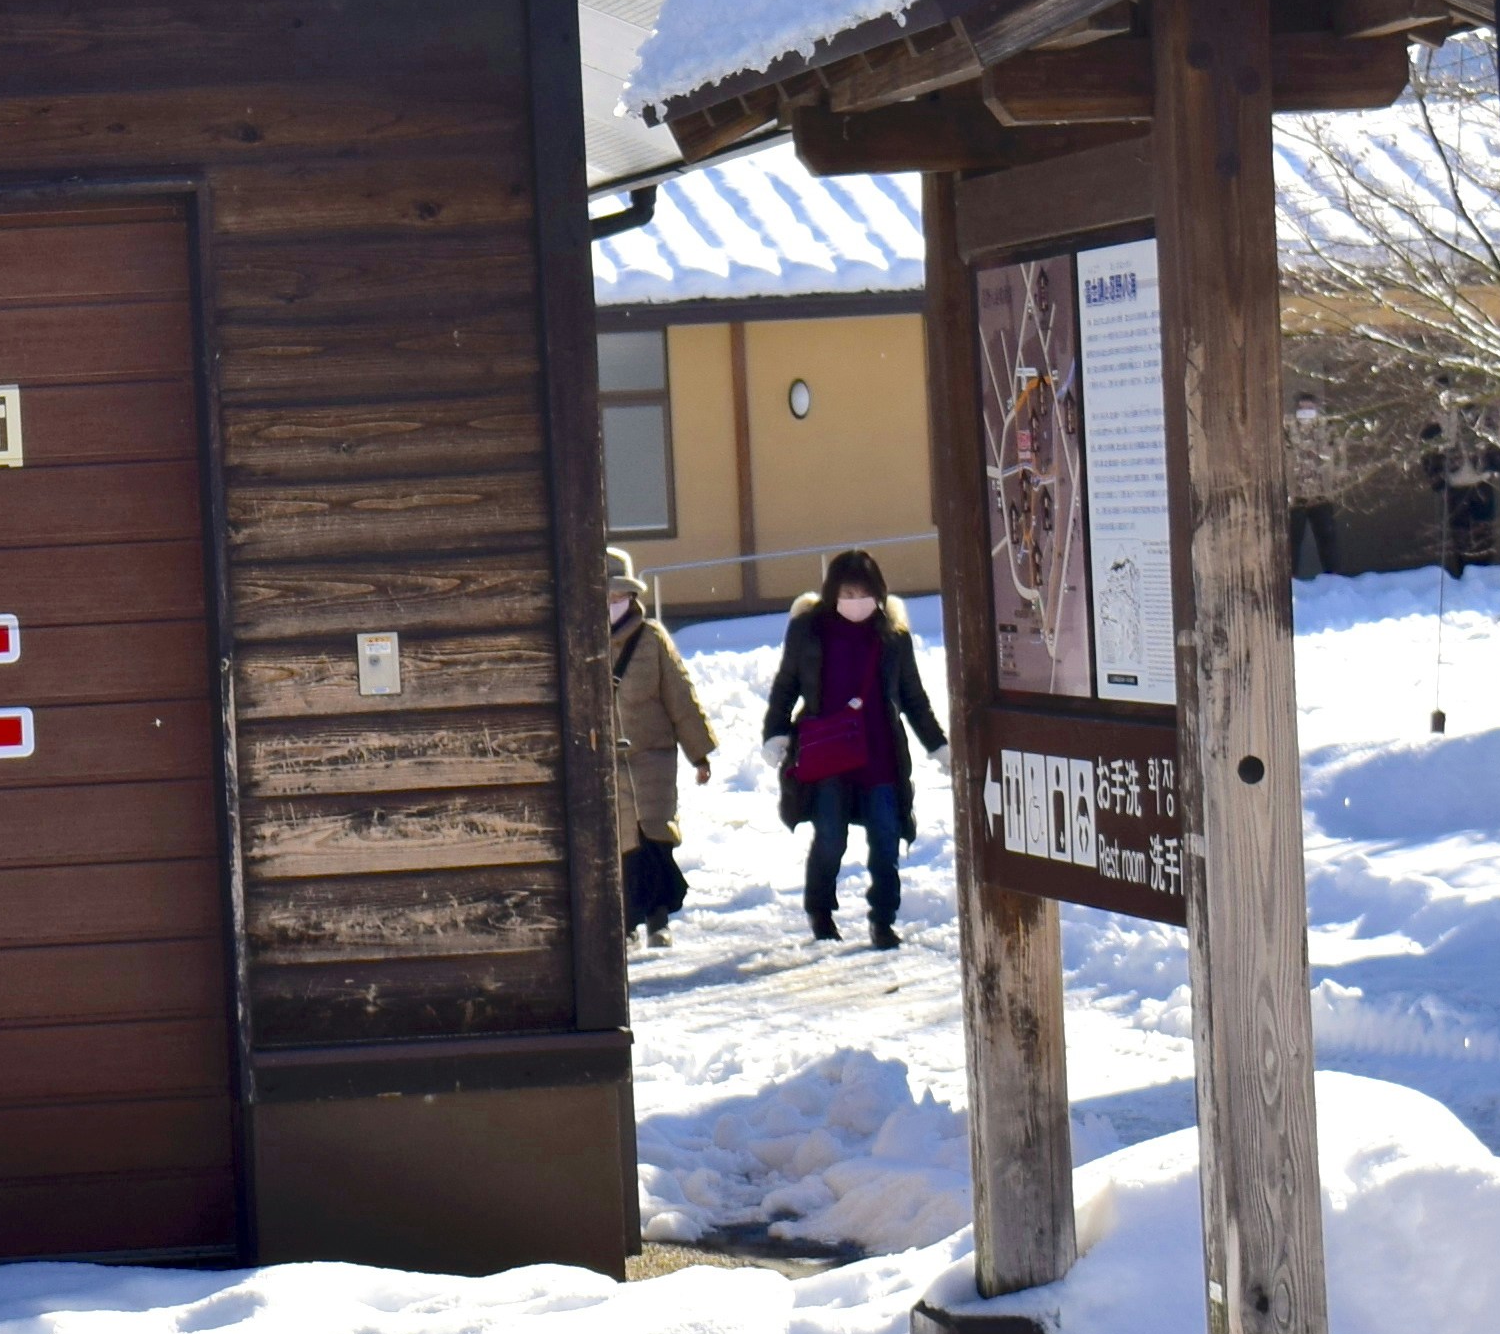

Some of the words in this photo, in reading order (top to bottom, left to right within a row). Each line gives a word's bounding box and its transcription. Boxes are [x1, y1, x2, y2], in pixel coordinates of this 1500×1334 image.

[1096, 755, 1142, 818] お手洗
[1147, 757, 1181, 817] 화장
[1098, 833, 1121, 879] Rest
[1121, 849, 1146, 884] room
[1149, 833, 1185, 897] 洗手
